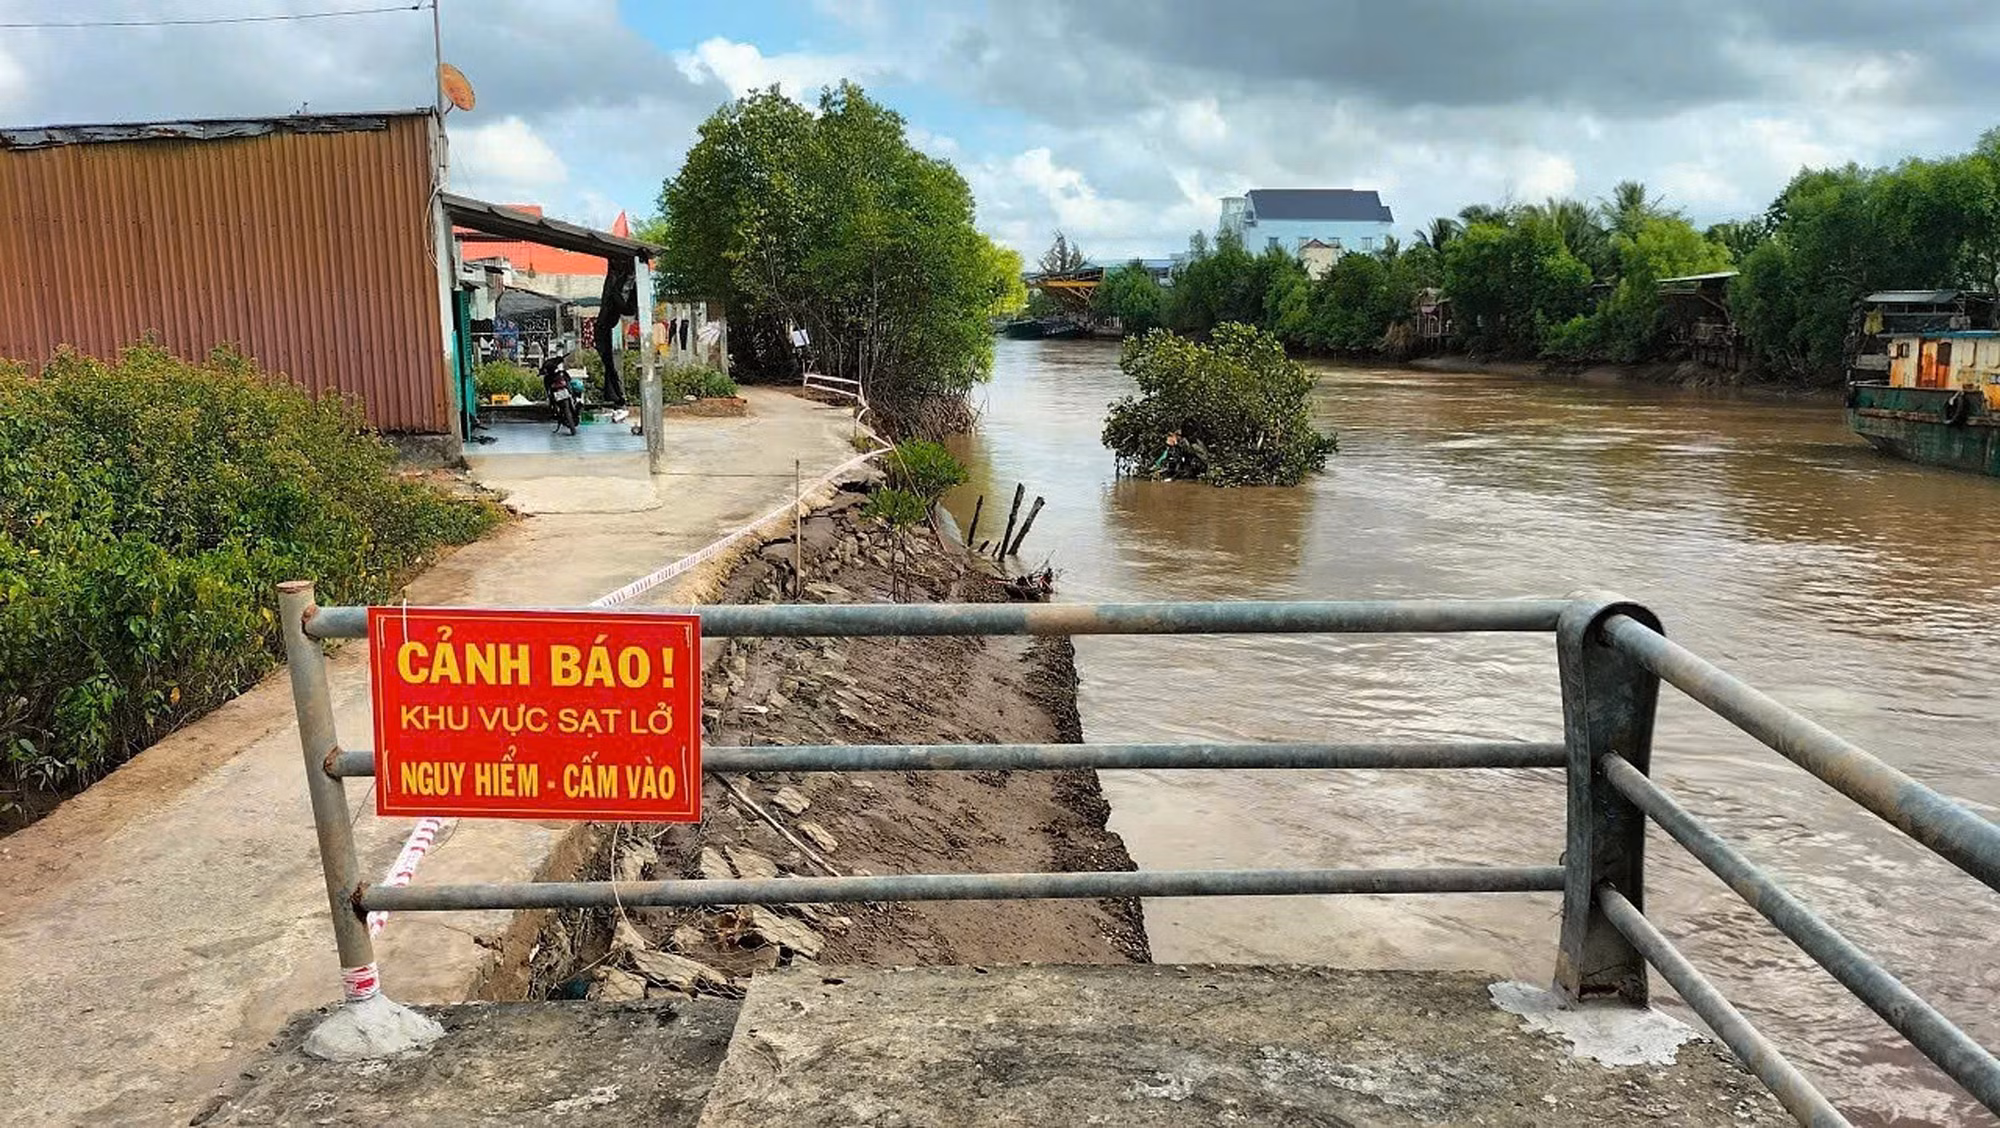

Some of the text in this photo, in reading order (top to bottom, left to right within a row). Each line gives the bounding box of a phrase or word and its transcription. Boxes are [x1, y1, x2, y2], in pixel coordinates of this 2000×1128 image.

[396, 625, 531, 686] CẢNH
[400, 702, 674, 738] KHU VỰC SẠT LỞ
[401, 761, 467, 797] NGUY
[475, 745, 540, 798] HIỂM
[563, 752, 619, 799] CẤM
[626, 755, 677, 800] VÀO
